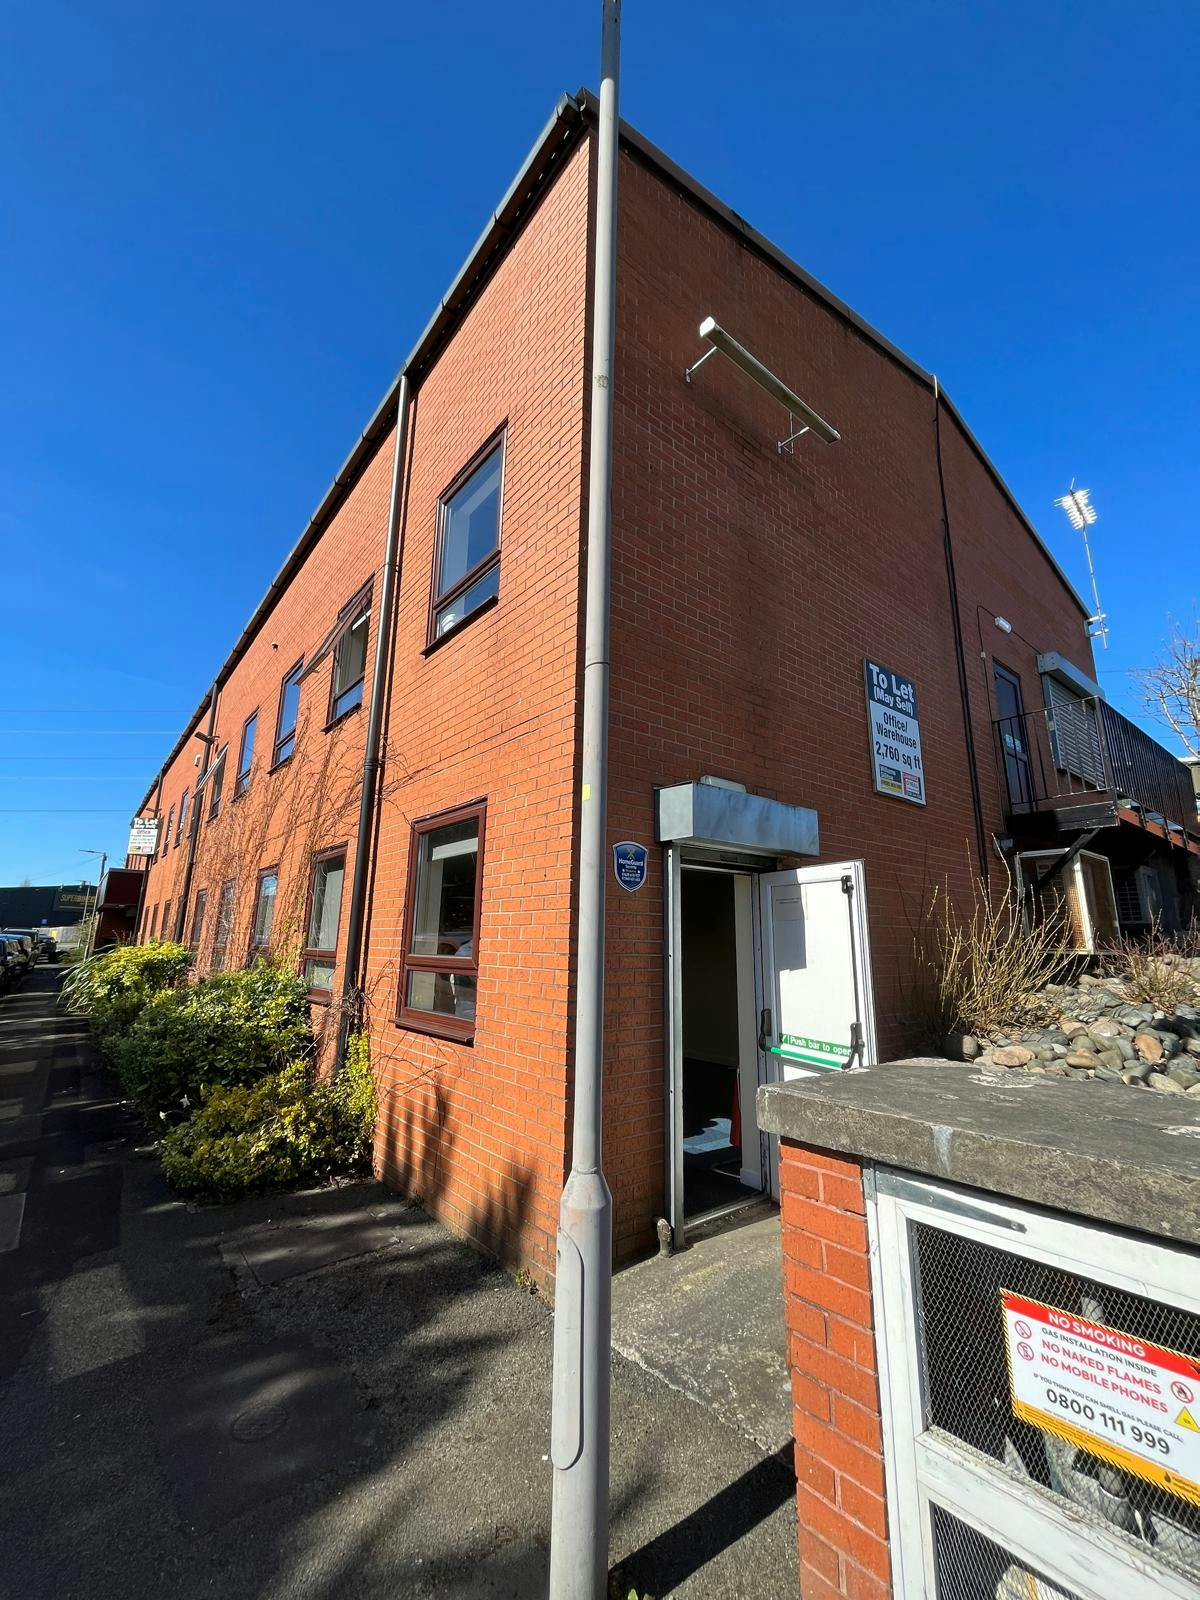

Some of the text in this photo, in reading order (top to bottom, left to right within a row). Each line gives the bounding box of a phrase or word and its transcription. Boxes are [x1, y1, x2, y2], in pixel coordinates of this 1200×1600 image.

[869, 663, 915, 703] To Let
[873, 685, 913, 717] (May Sell)
[876, 722, 917, 749] Warehouse
[883, 712, 908, 732] Office/
[876, 741, 921, 770] 2,760 sq ft
[790, 1036, 807, 1046] Push
[808, 1040, 820, 1050] bar
[823, 1043, 830, 1051] to
[1041, 1327, 1157, 1377] GAS INSTALLATION INSIDE
[1048, 1312, 1146, 1357] NO SMOKING
[1041, 1340, 1161, 1395] NO NAKED FLAMES
[1041, 1354, 1168, 1413] NO MOBILE PHONES
[1040, 1376, 1052, 1385] YOU
[1053, 1381, 1071, 1393] THINK
[1071, 1389, 1084, 1399] YOU
[1085, 1395, 1099, 1405] CAN
[1100, 1402, 1121, 1415] SMELL
[1122, 1411, 1135, 1421] GAS
[1136, 1417, 1162, 1432] PLEASE
[1047, 1389, 1094, 1420] 0800
[1099, 1413, 1125, 1435] 111
[1131, 1426, 1169, 1455] 999
